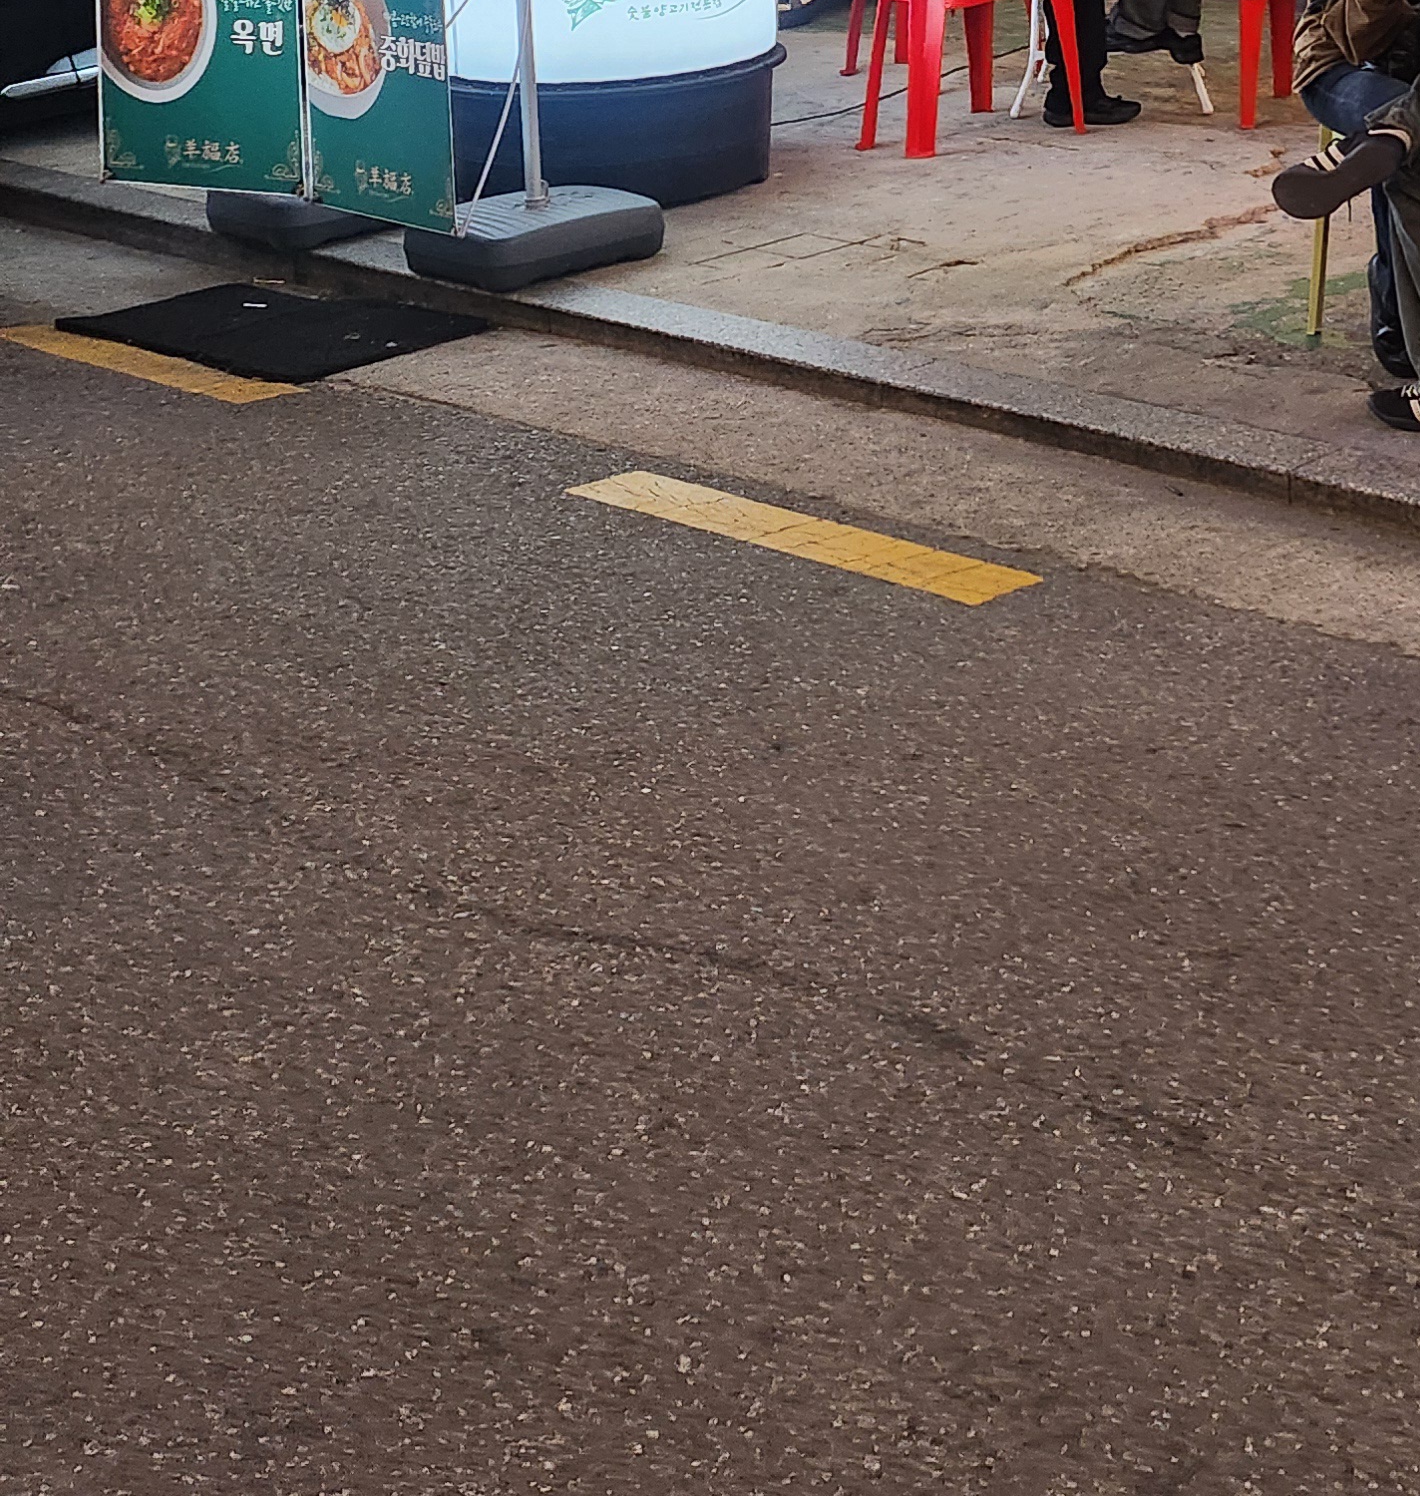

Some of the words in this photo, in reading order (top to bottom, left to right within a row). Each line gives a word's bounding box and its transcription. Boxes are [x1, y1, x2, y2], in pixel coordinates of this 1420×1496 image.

[230, 19, 284, 56] 옥면
[378, 35, 446, 82] 중화덮밥
[182, 138, 243, 164] 羊福店
